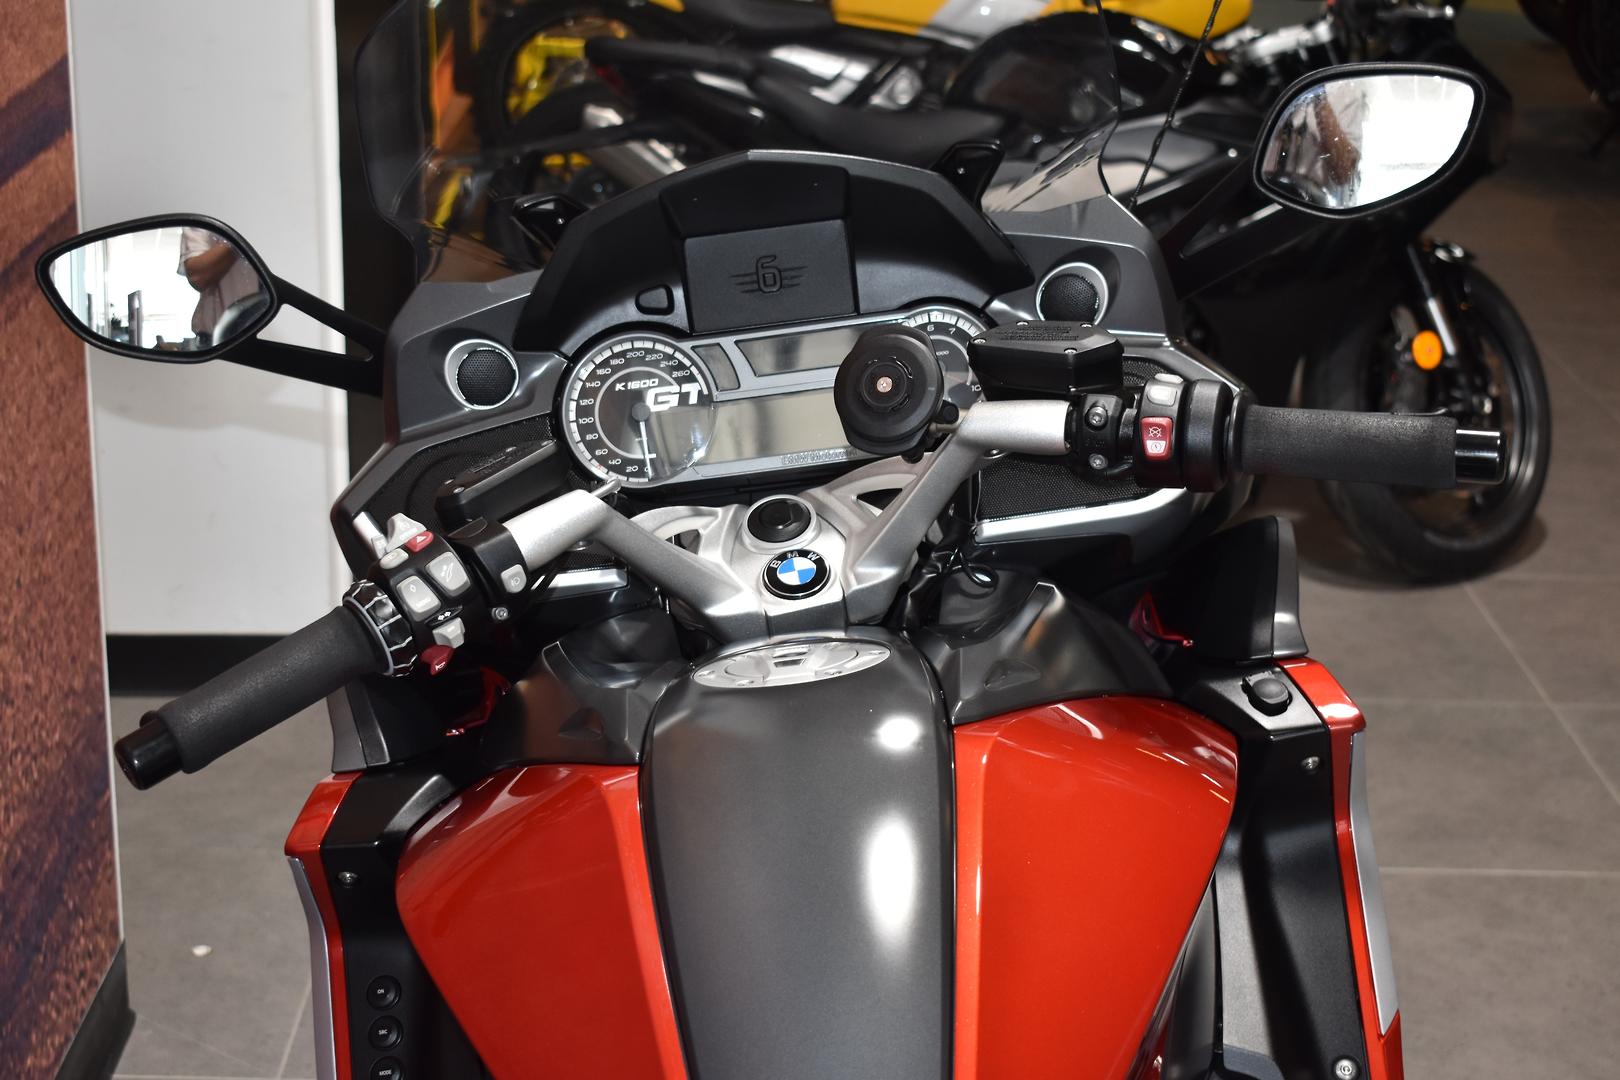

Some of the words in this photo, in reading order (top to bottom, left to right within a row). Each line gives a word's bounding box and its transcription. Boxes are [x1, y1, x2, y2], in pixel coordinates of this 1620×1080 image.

[757, 254, 783, 293] 6
[927, 324, 935, 332] 6
[949, 327, 956, 335] 7
[626, 350, 645, 359] 200
[645, 352, 664, 361] 220
[610, 358, 625, 366] 180
[660, 359, 679, 368] 240
[596, 367, 612, 375] 160
[672, 369, 690, 378] 260
[586, 380, 601, 388] 140
[615, 382, 626, 392] K
[627, 378, 659, 390] 1600
[971, 384, 982, 392] 10
[646, 382, 702, 412] GT
[580, 398, 595, 406] 120
[579, 417, 594, 425] 100
[595, 448, 609, 456] 60
[609, 458, 622, 466] 40
[626, 465, 639, 473] 20
[770, 551, 821, 568] BMW
